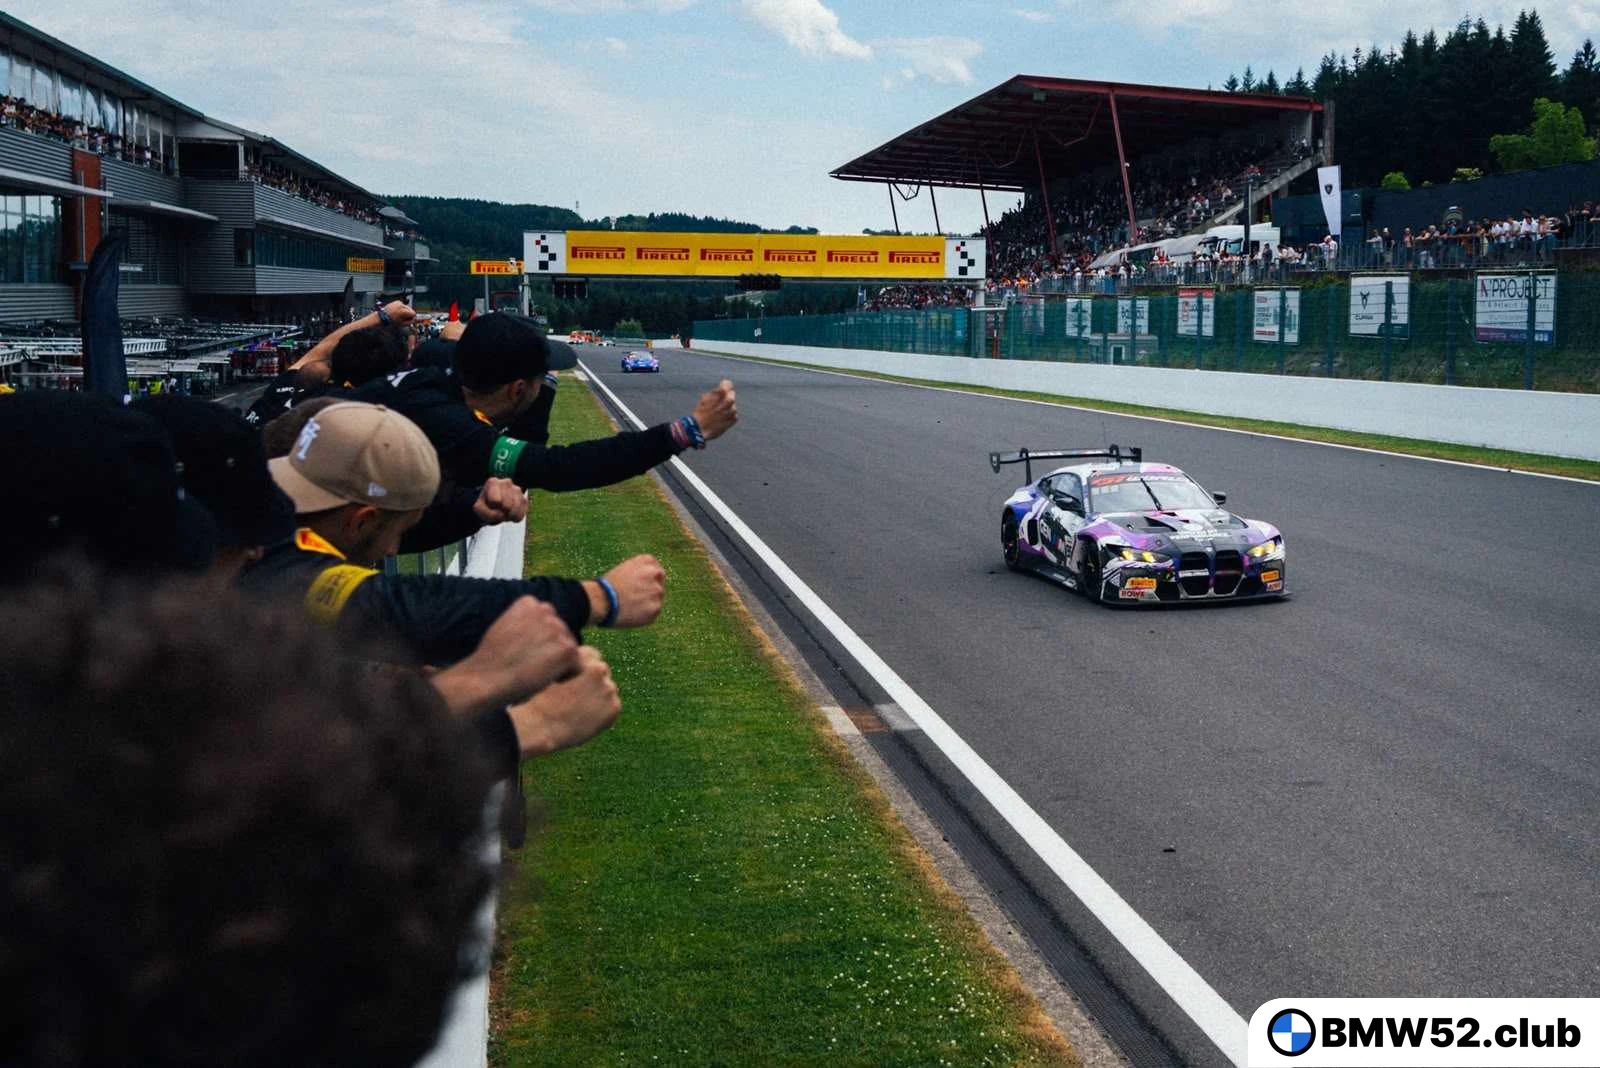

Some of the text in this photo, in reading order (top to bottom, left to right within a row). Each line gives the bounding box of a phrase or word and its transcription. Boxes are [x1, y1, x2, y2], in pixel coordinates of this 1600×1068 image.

[571, 245, 940, 263] PIRELLI PIRELLI PIRELLI PIRELLI PIRELLI PIRELLI
[475, 261, 522, 273] PIRELI
